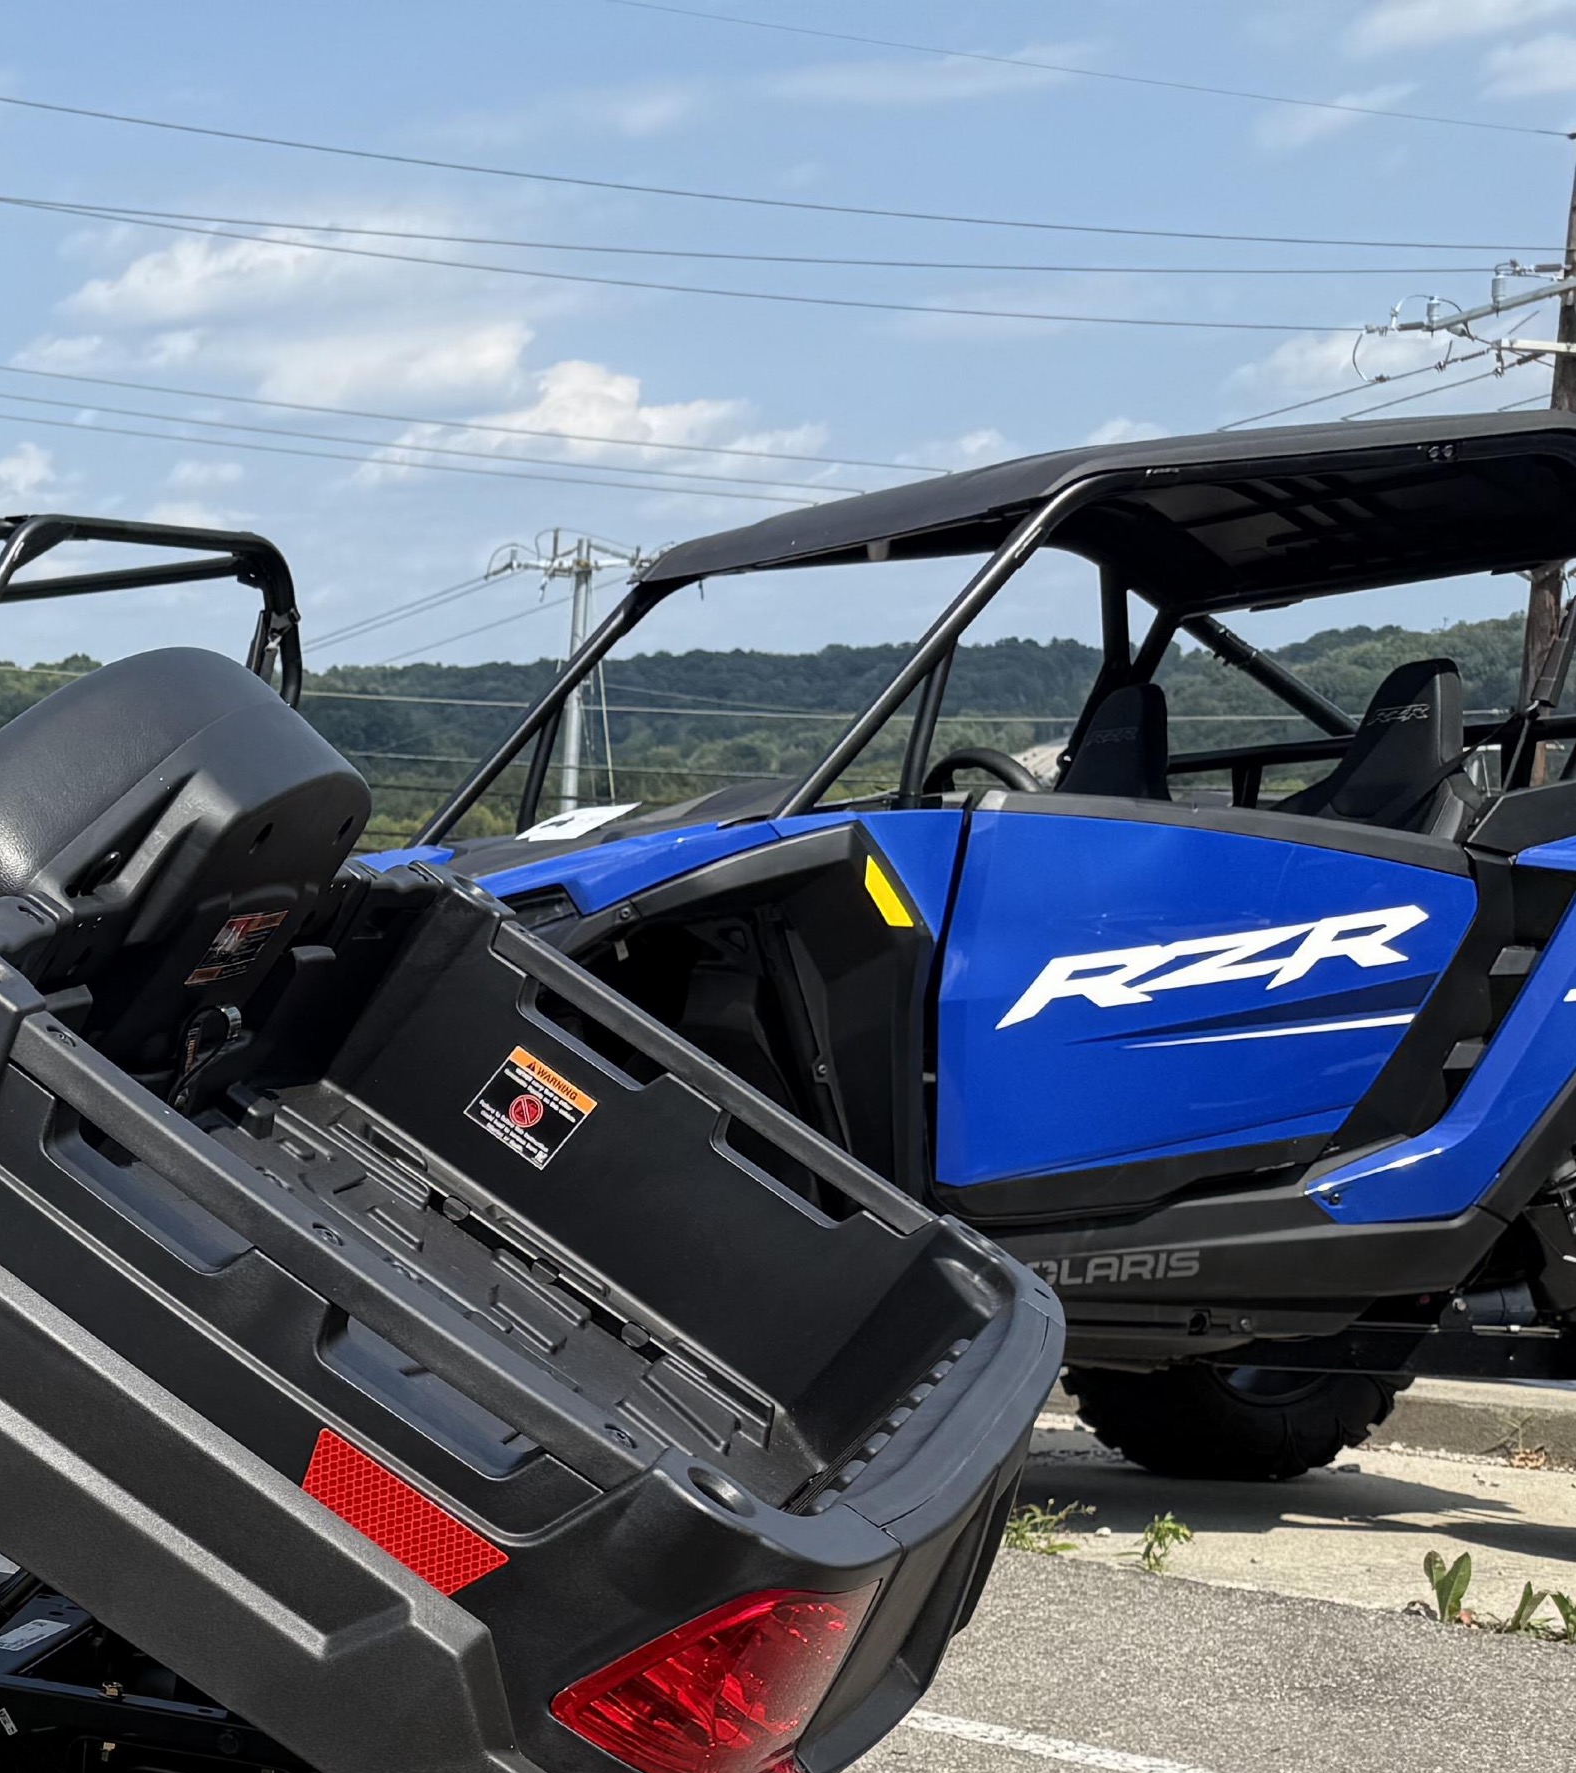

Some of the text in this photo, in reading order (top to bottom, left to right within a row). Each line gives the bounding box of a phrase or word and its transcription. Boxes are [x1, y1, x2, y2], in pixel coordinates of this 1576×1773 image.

[996, 904, 1430, 1031] RZR
[537, 1065, 579, 1101] WARNING
[1027, 1251, 1201, 1286] OLARIS
